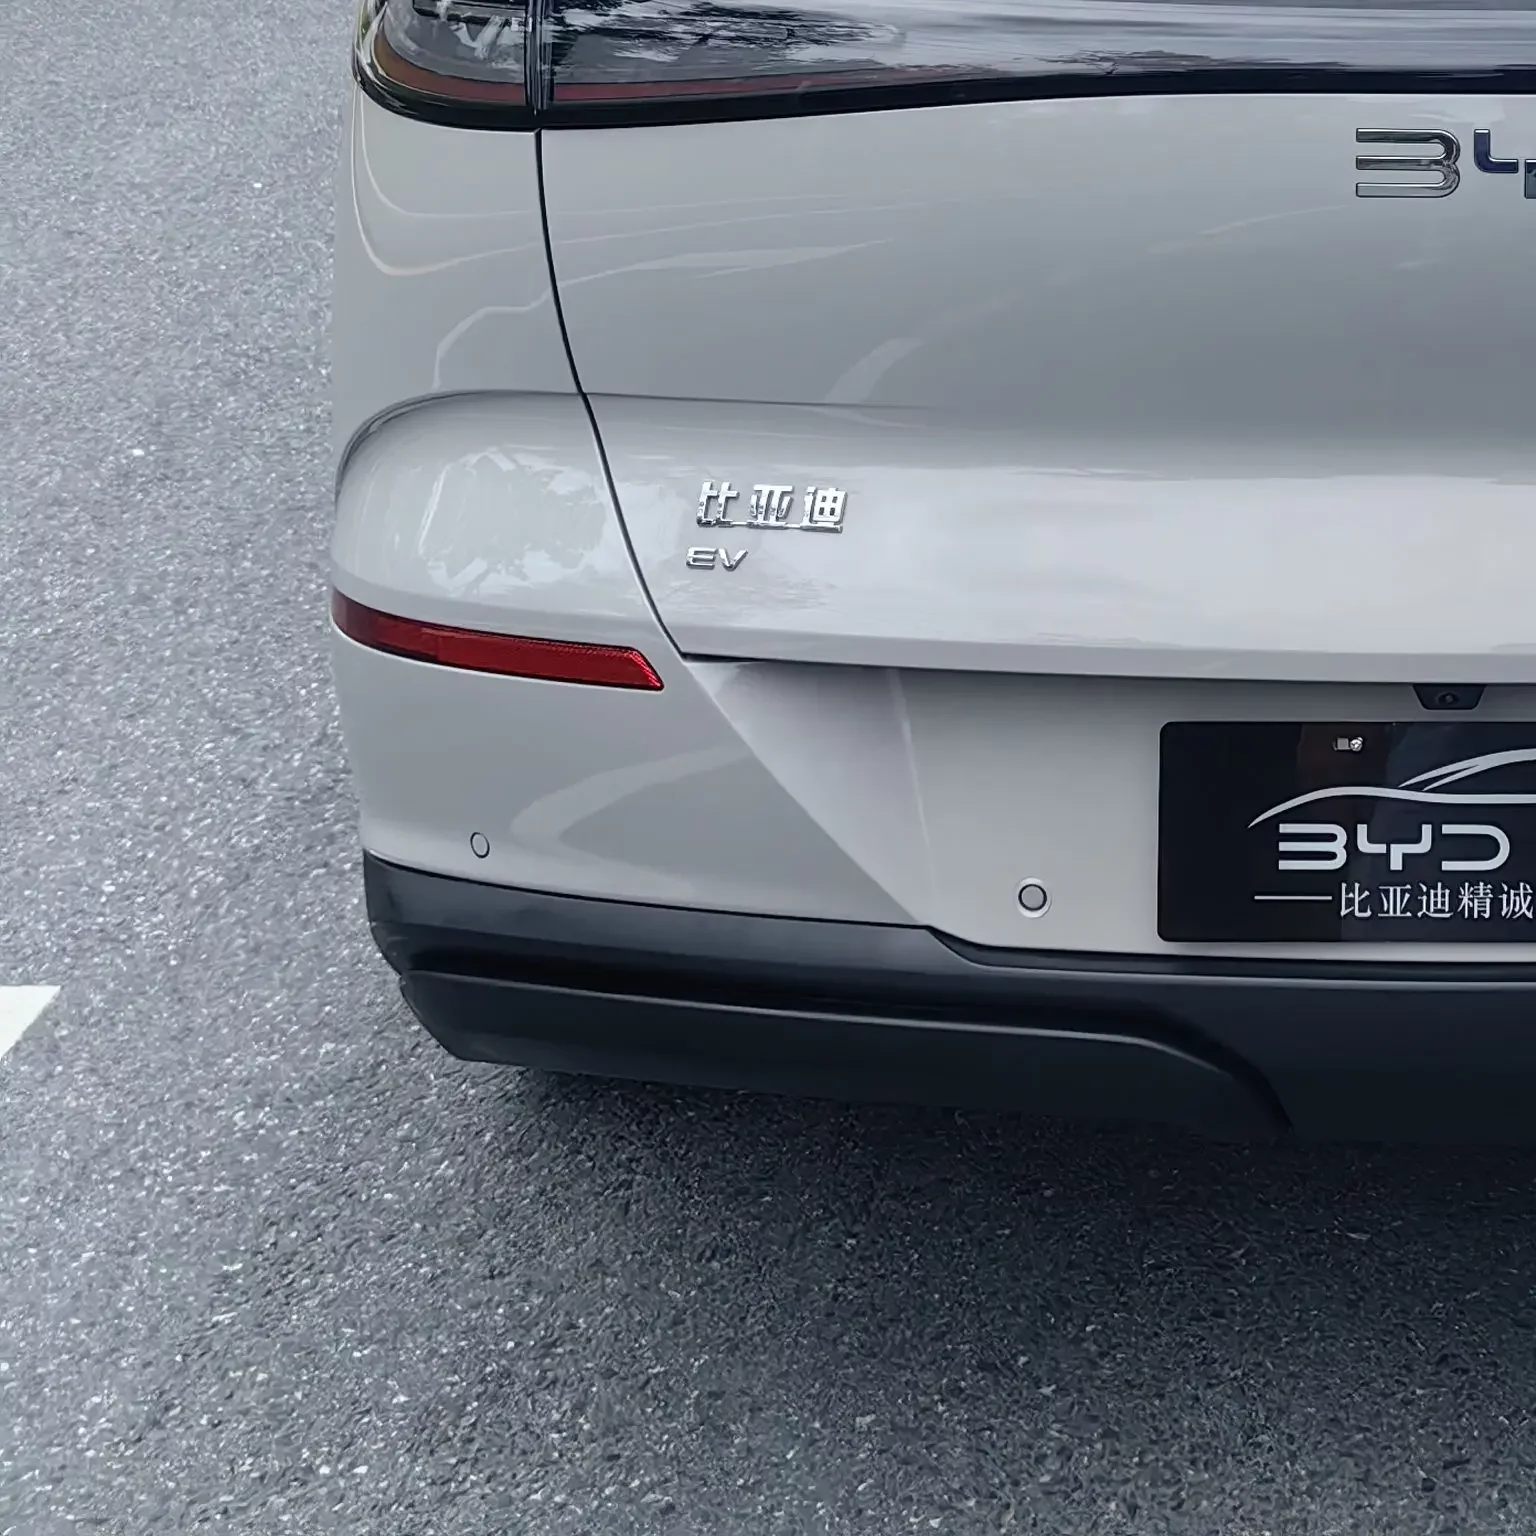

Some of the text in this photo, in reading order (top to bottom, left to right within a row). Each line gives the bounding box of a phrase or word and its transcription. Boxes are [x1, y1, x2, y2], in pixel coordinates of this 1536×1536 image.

[696, 480, 848, 533] 比亚迪
[686, 547, 748, 572] EV
[1278, 823, 1511, 872] BYD
